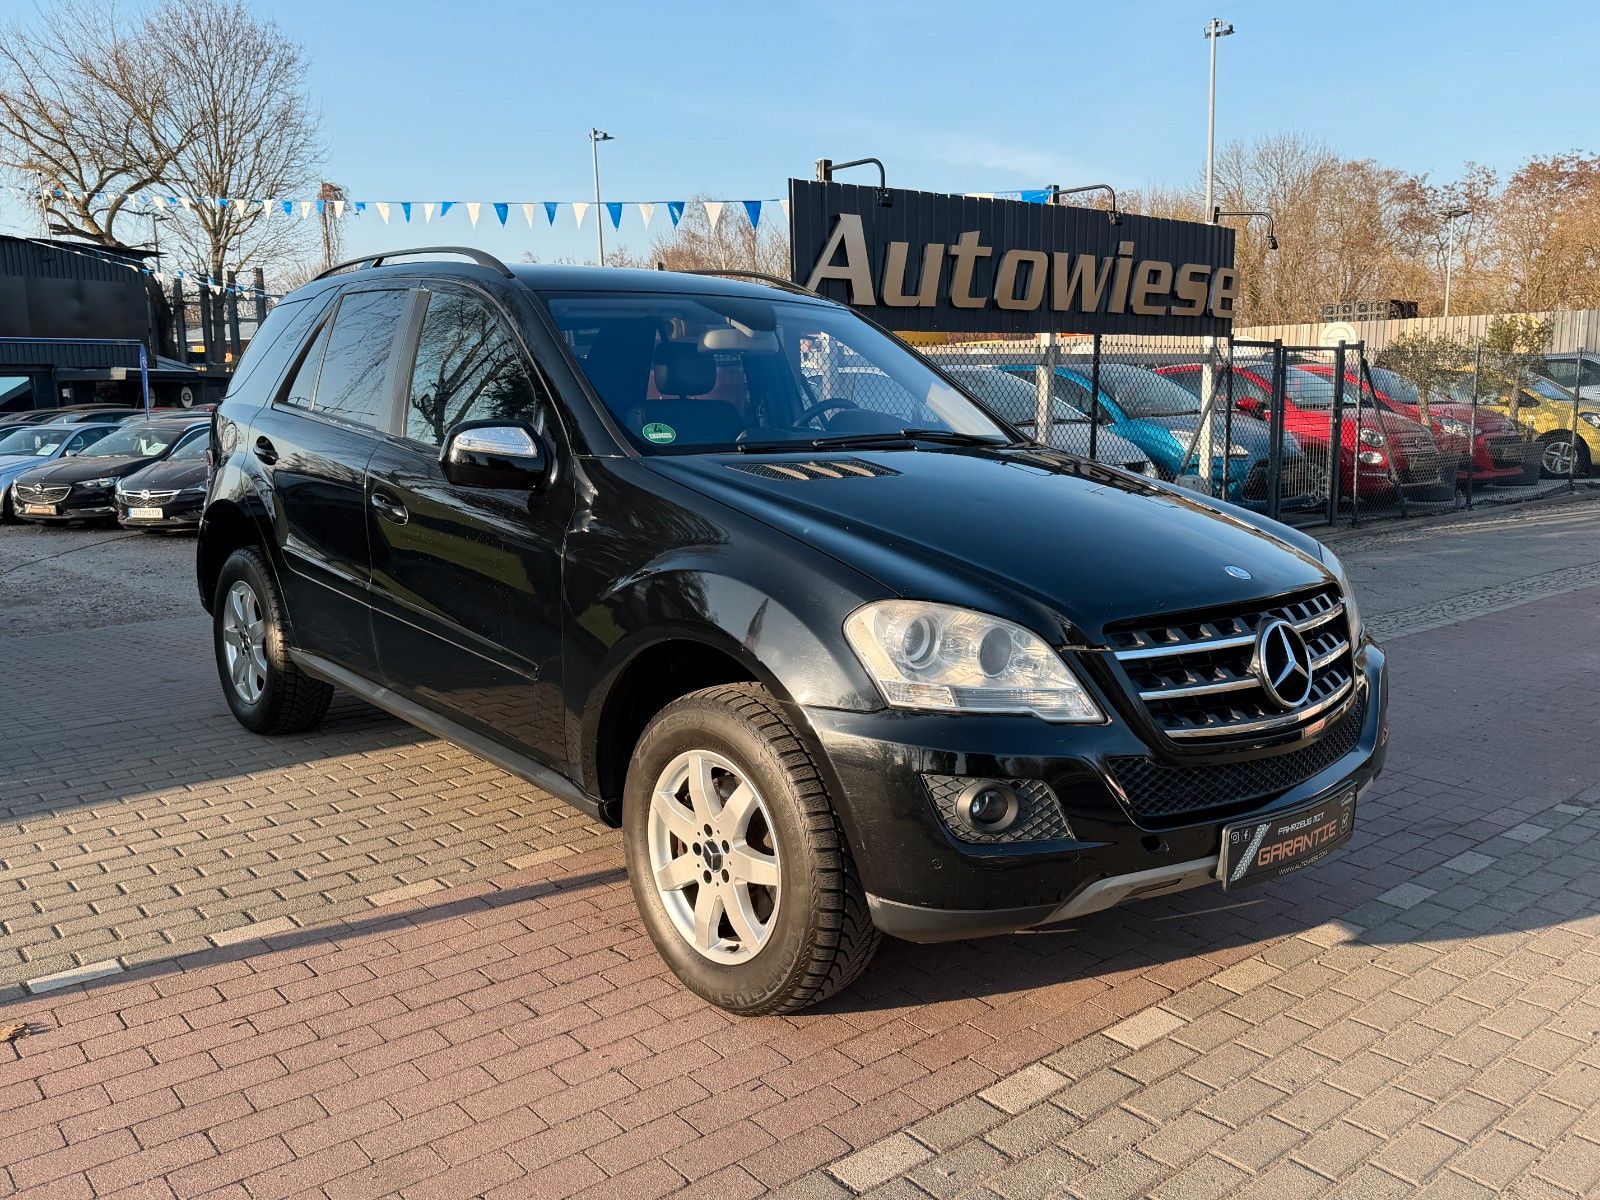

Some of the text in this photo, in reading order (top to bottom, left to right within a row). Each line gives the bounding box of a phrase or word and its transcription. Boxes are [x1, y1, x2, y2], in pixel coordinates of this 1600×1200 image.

[805, 212, 1239, 319] Autowiese
[653, 423, 663, 433] 4
[133, 509, 161, 517] AUTOMATIK
[1278, 816, 1312, 836] FAHRZEUG
[1312, 812, 1325, 823] MIT
[1258, 819, 1338, 866] GARANTIE
